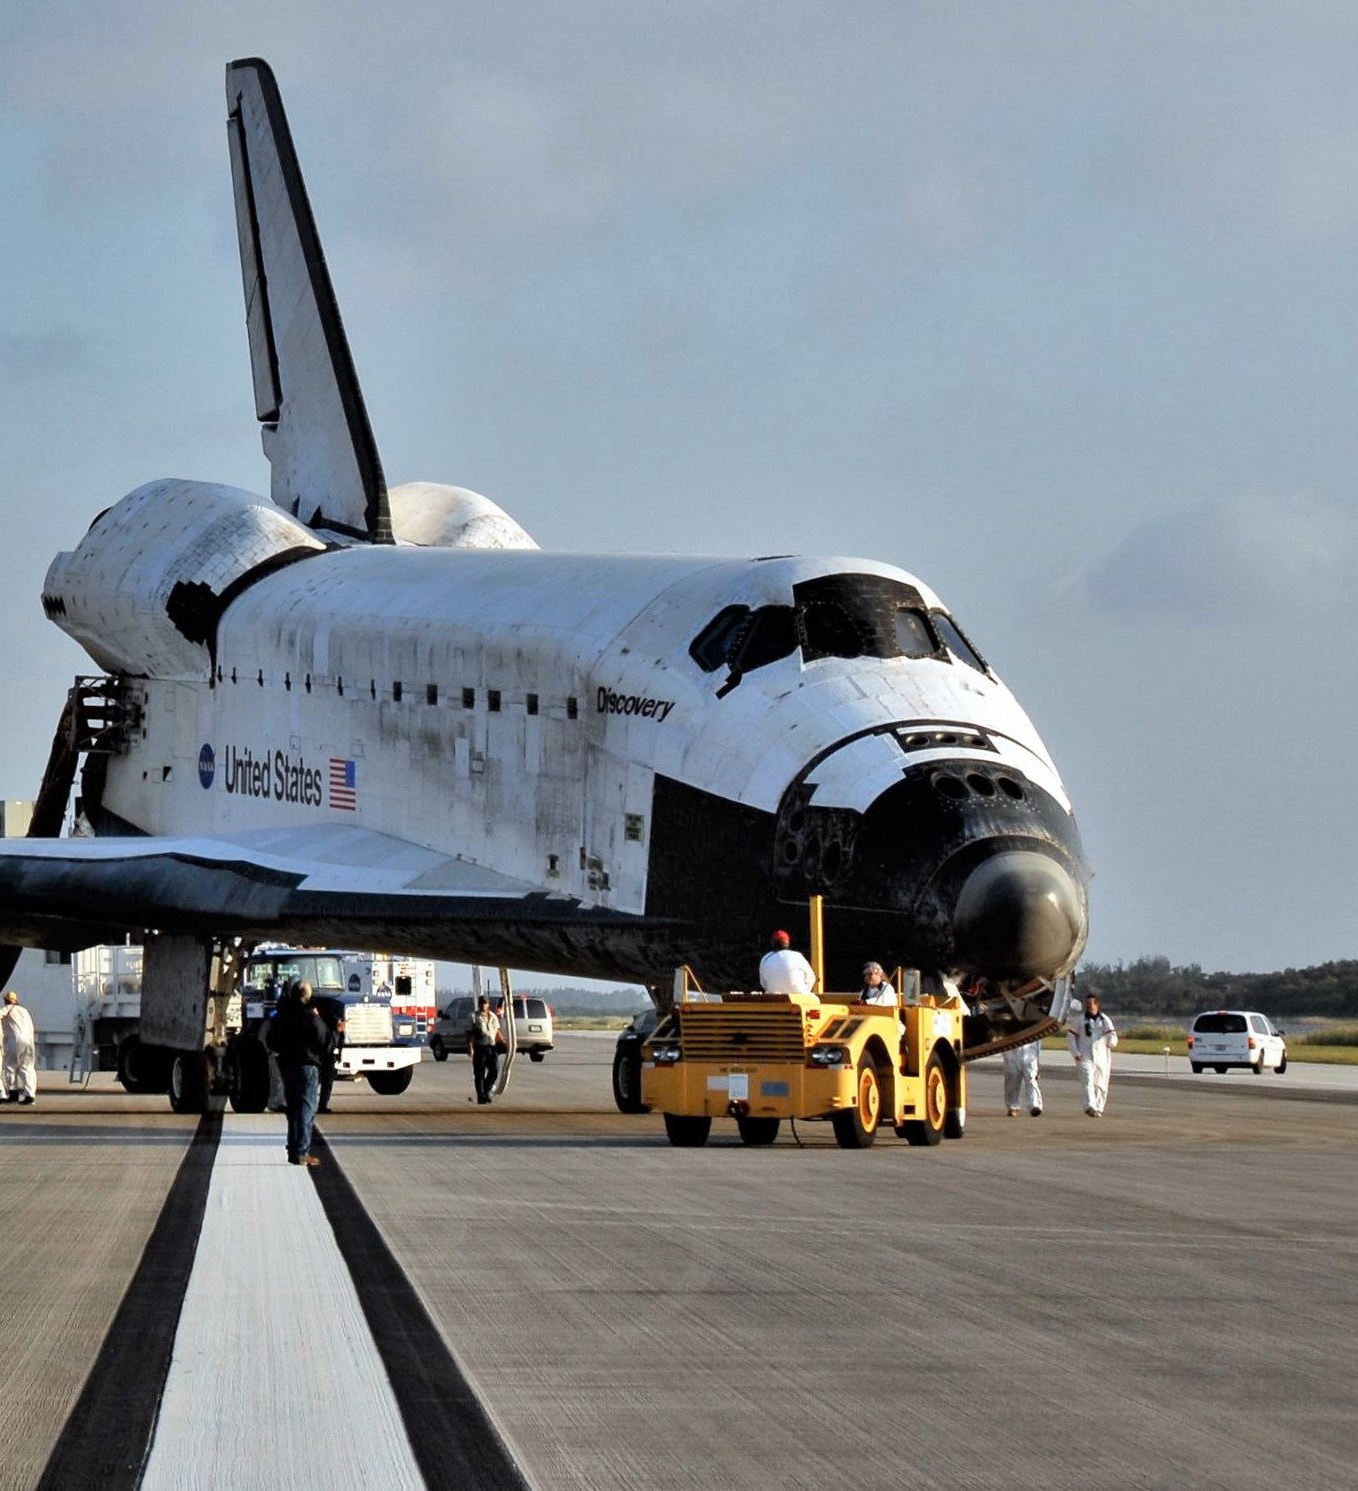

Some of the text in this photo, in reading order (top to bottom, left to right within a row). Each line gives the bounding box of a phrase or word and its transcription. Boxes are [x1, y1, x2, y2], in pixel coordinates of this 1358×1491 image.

[597, 686, 676, 723] Discovery
[225, 745, 322, 807] United States
